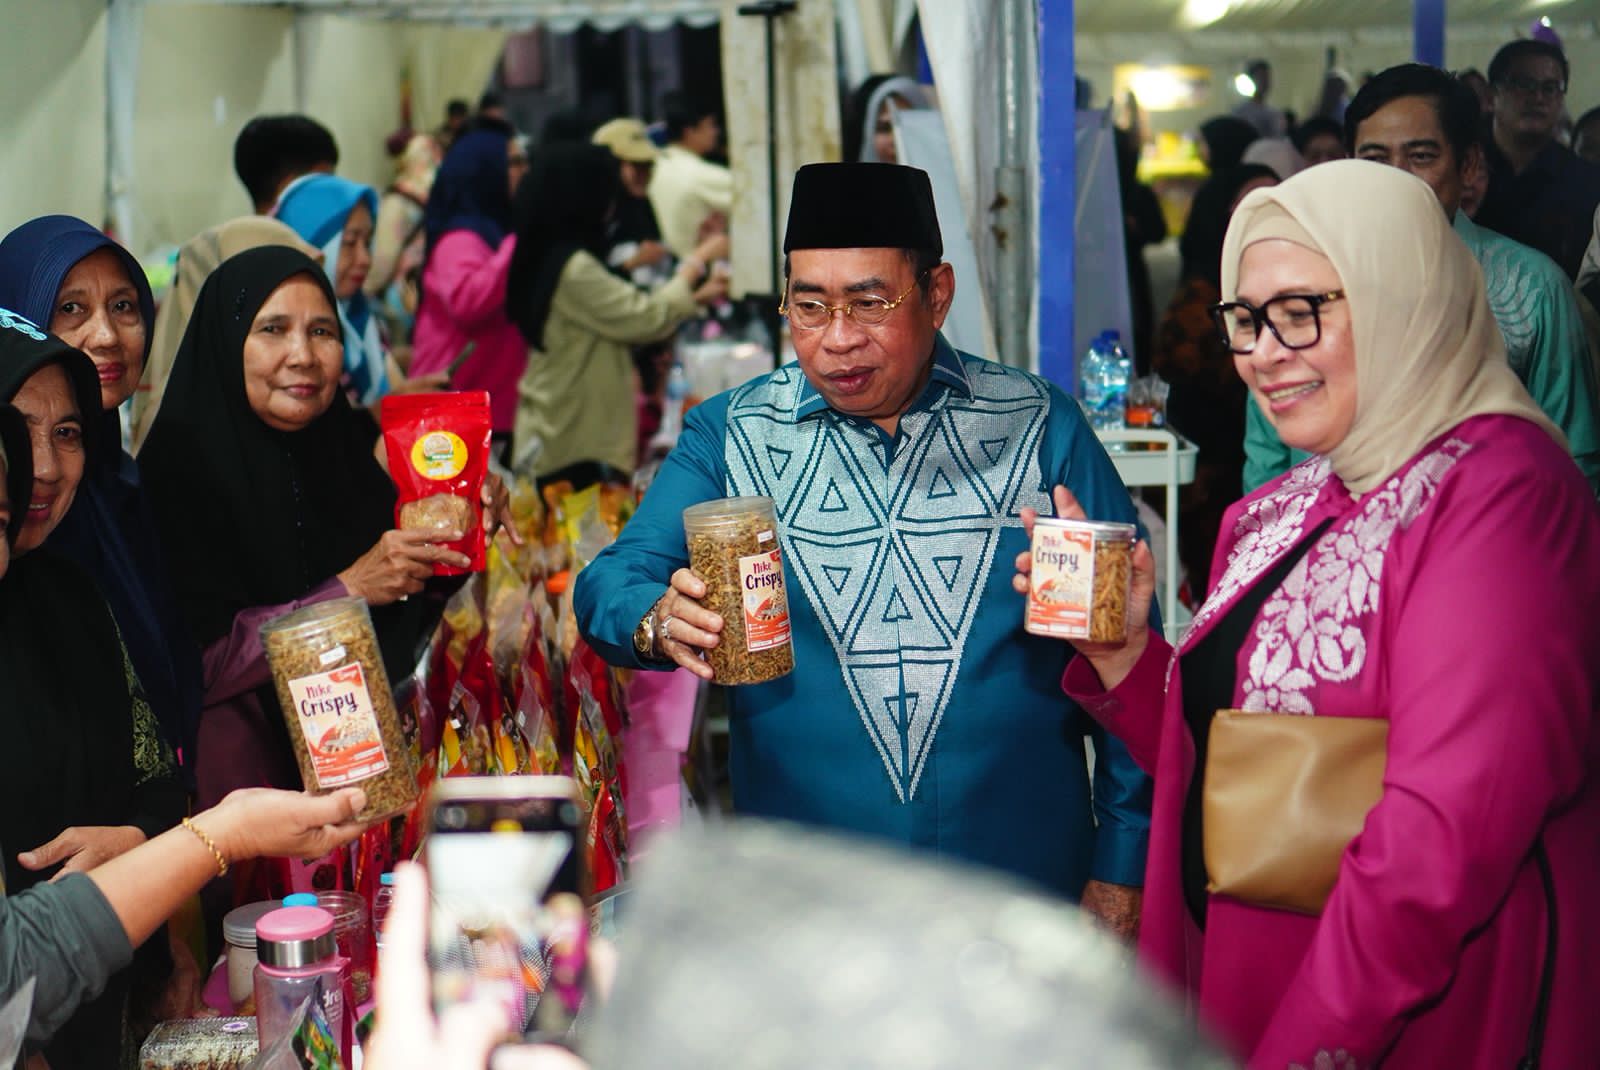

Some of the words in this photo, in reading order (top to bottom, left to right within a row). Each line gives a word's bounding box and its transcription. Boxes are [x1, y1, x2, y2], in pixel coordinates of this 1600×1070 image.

[752, 561, 772, 574] Nike
[1035, 546, 1080, 573] Crispy
[745, 570, 783, 590] Crispy
[305, 684, 332, 699] Nike
[301, 692, 359, 717] Crispy
